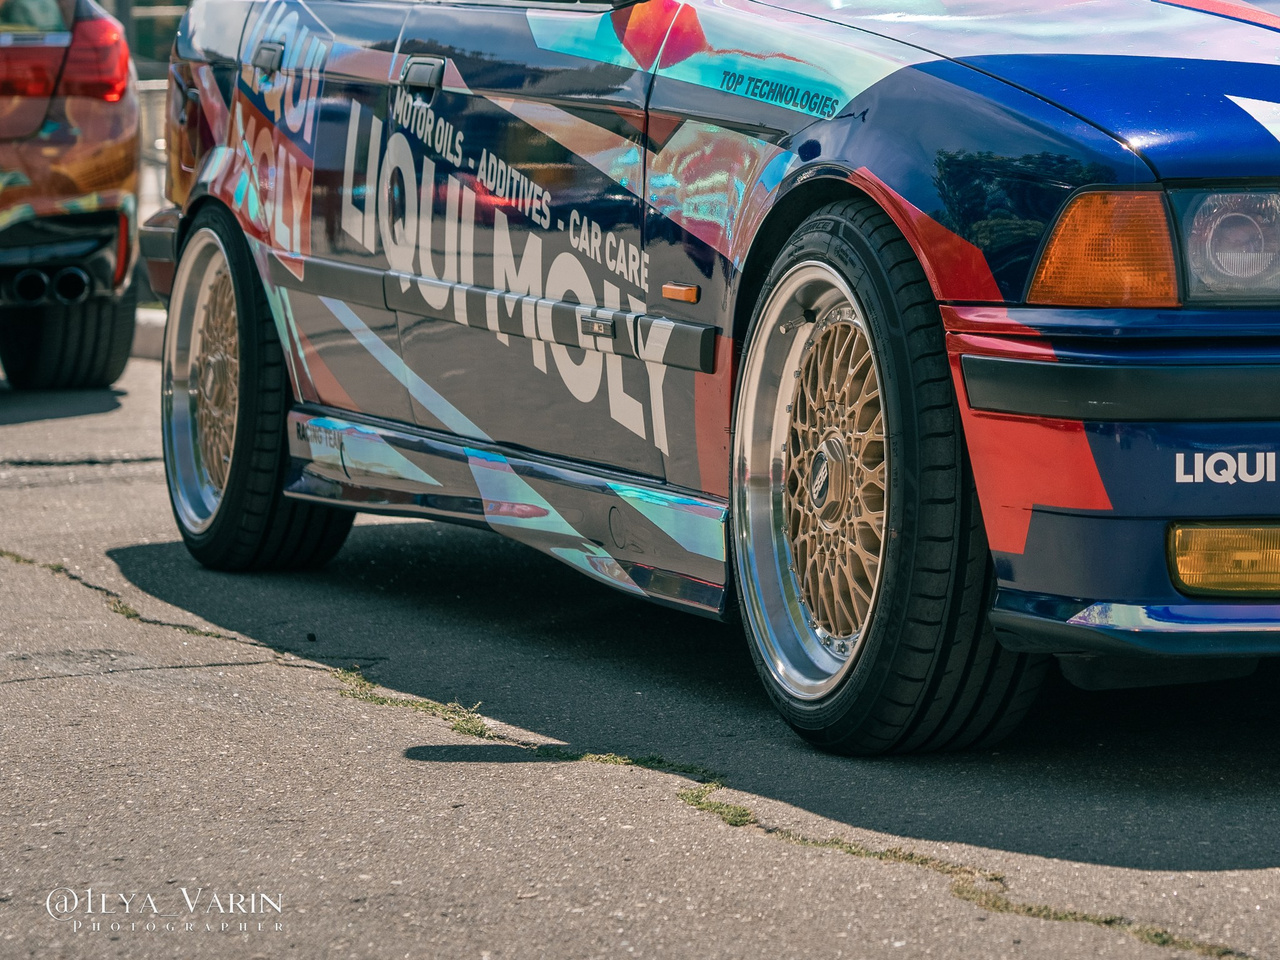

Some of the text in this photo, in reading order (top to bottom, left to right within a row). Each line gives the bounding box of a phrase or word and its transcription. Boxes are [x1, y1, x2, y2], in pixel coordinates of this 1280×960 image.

[720, 70, 839, 119] TOP TECHNOLOGIES
[392, 86, 435, 148] MOTOR
[434, 116, 465, 168] OILS
[476, 147, 552, 230] ADDITIVES
[569, 209, 602, 265] CAR
[605, 231, 650, 293] CARE
[341, 98, 676, 458] LIQUI MOLY
[1175, 451, 1277, 485] LIQUI
